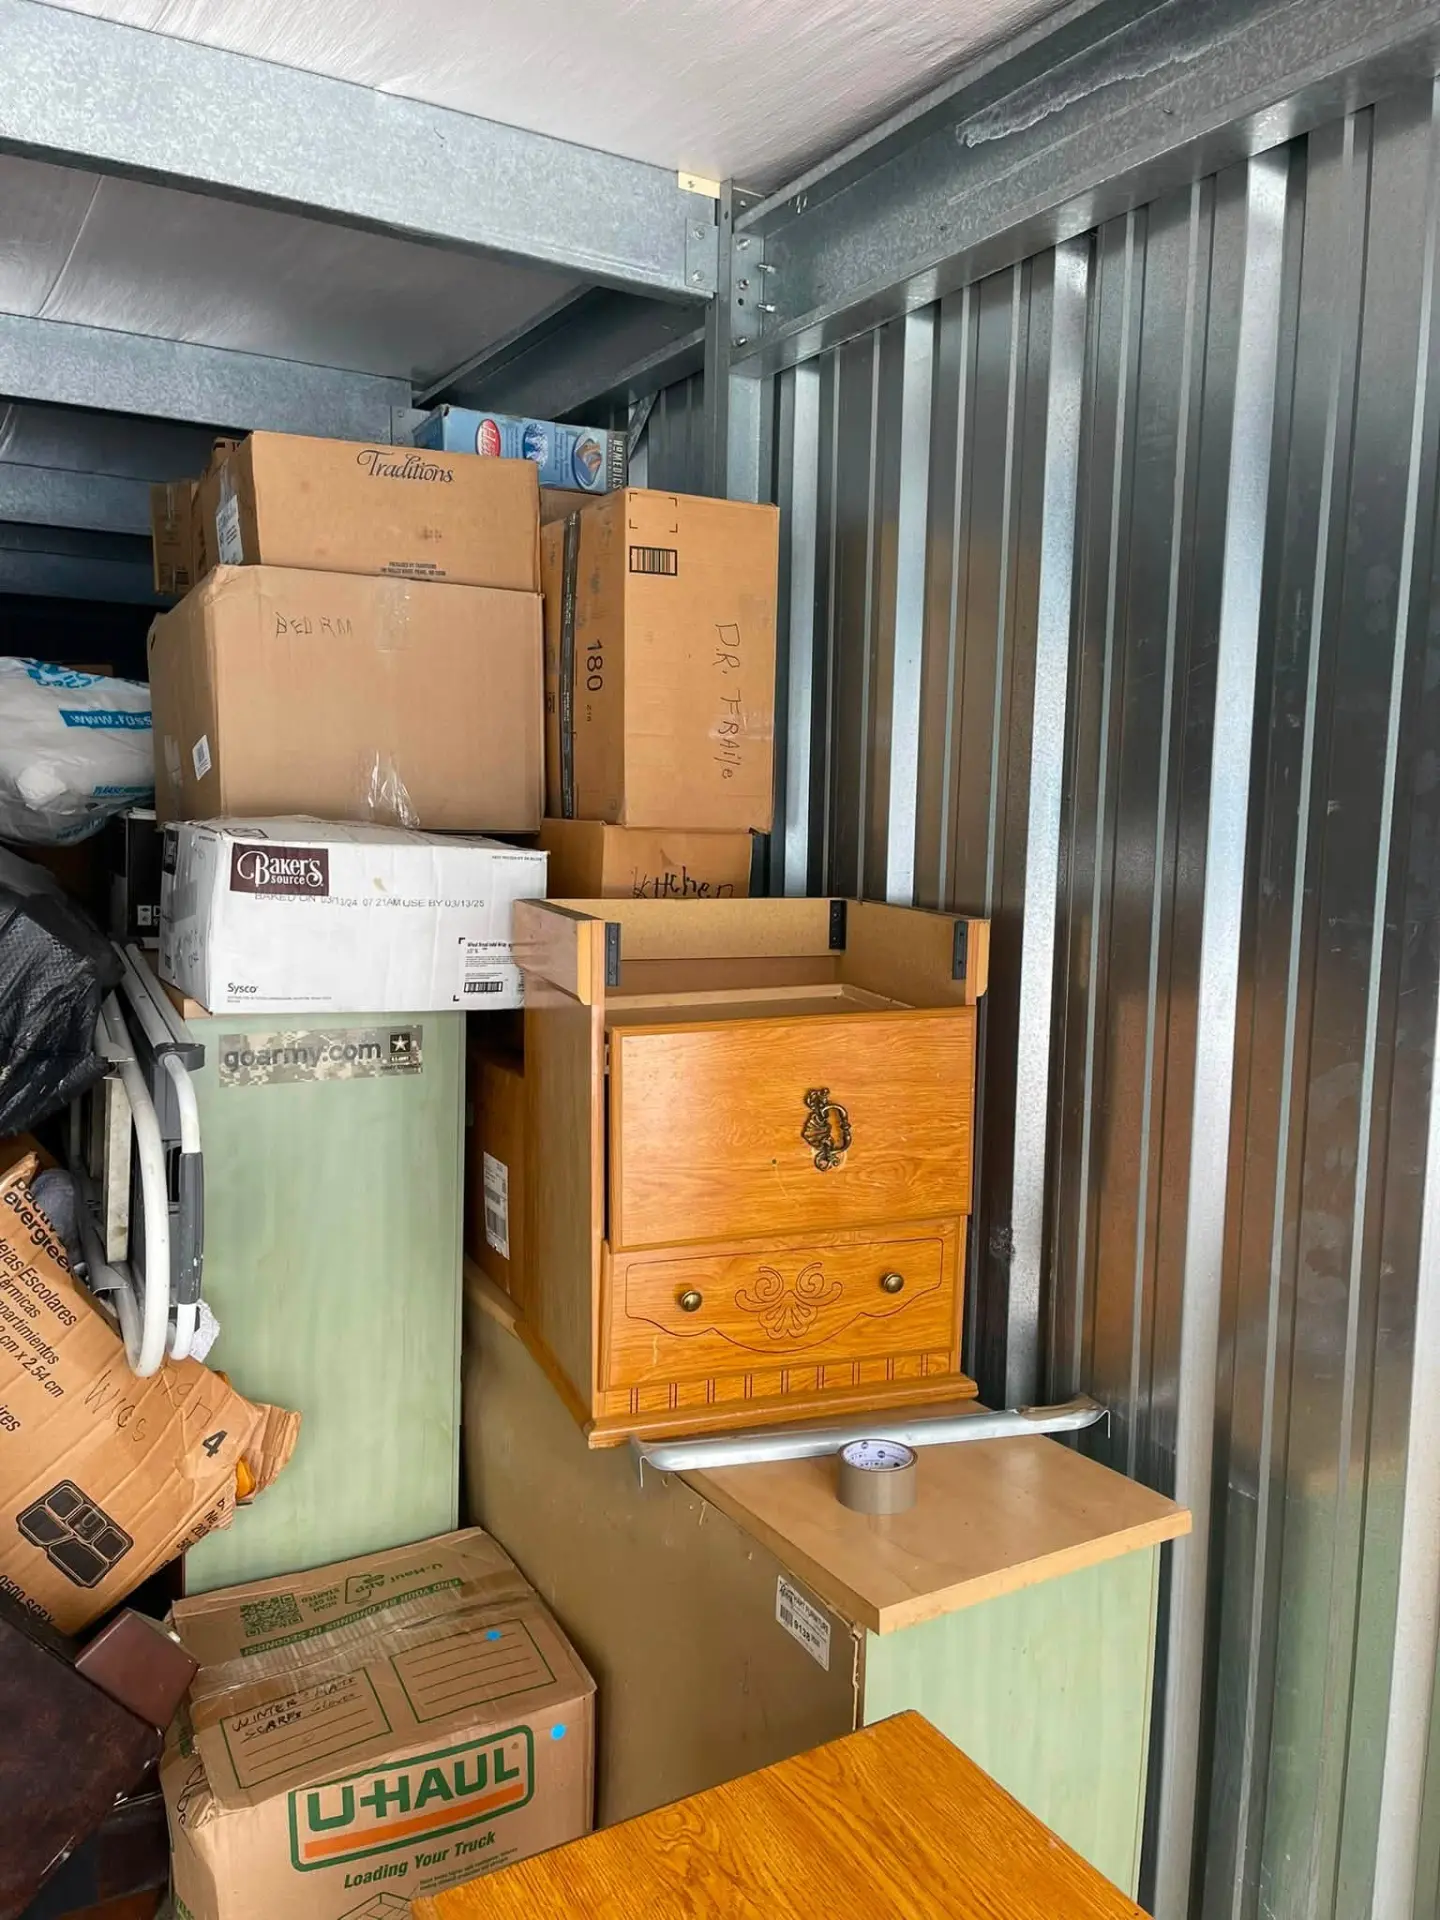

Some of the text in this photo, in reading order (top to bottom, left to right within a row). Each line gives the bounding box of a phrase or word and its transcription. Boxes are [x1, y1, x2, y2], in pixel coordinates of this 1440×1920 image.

[356, 449, 455, 483] Traditions
[586, 640, 604, 691] 180
[237, 851, 324, 888] Baker's
[271, 875, 306, 885] source
[402, 899, 427, 908] USE
[428, 899, 443, 908] BY
[444, 899, 485, 909] 03/13/25
[227, 982, 258, 994] Sysco
[224, 1042, 382, 1073] goarmy.com
[18, 1267, 77, 1327] Escolares
[14, 1351, 28, 1361] x
[44, 1380, 65, 1398] cm
[202, 1430, 228, 1458] 4
[307, 1747, 520, 1832] U-HAUL
[344, 1861, 408, 1888] Loading
[414, 1848, 450, 1869] Your
[455, 1831, 496, 1856] Truck
